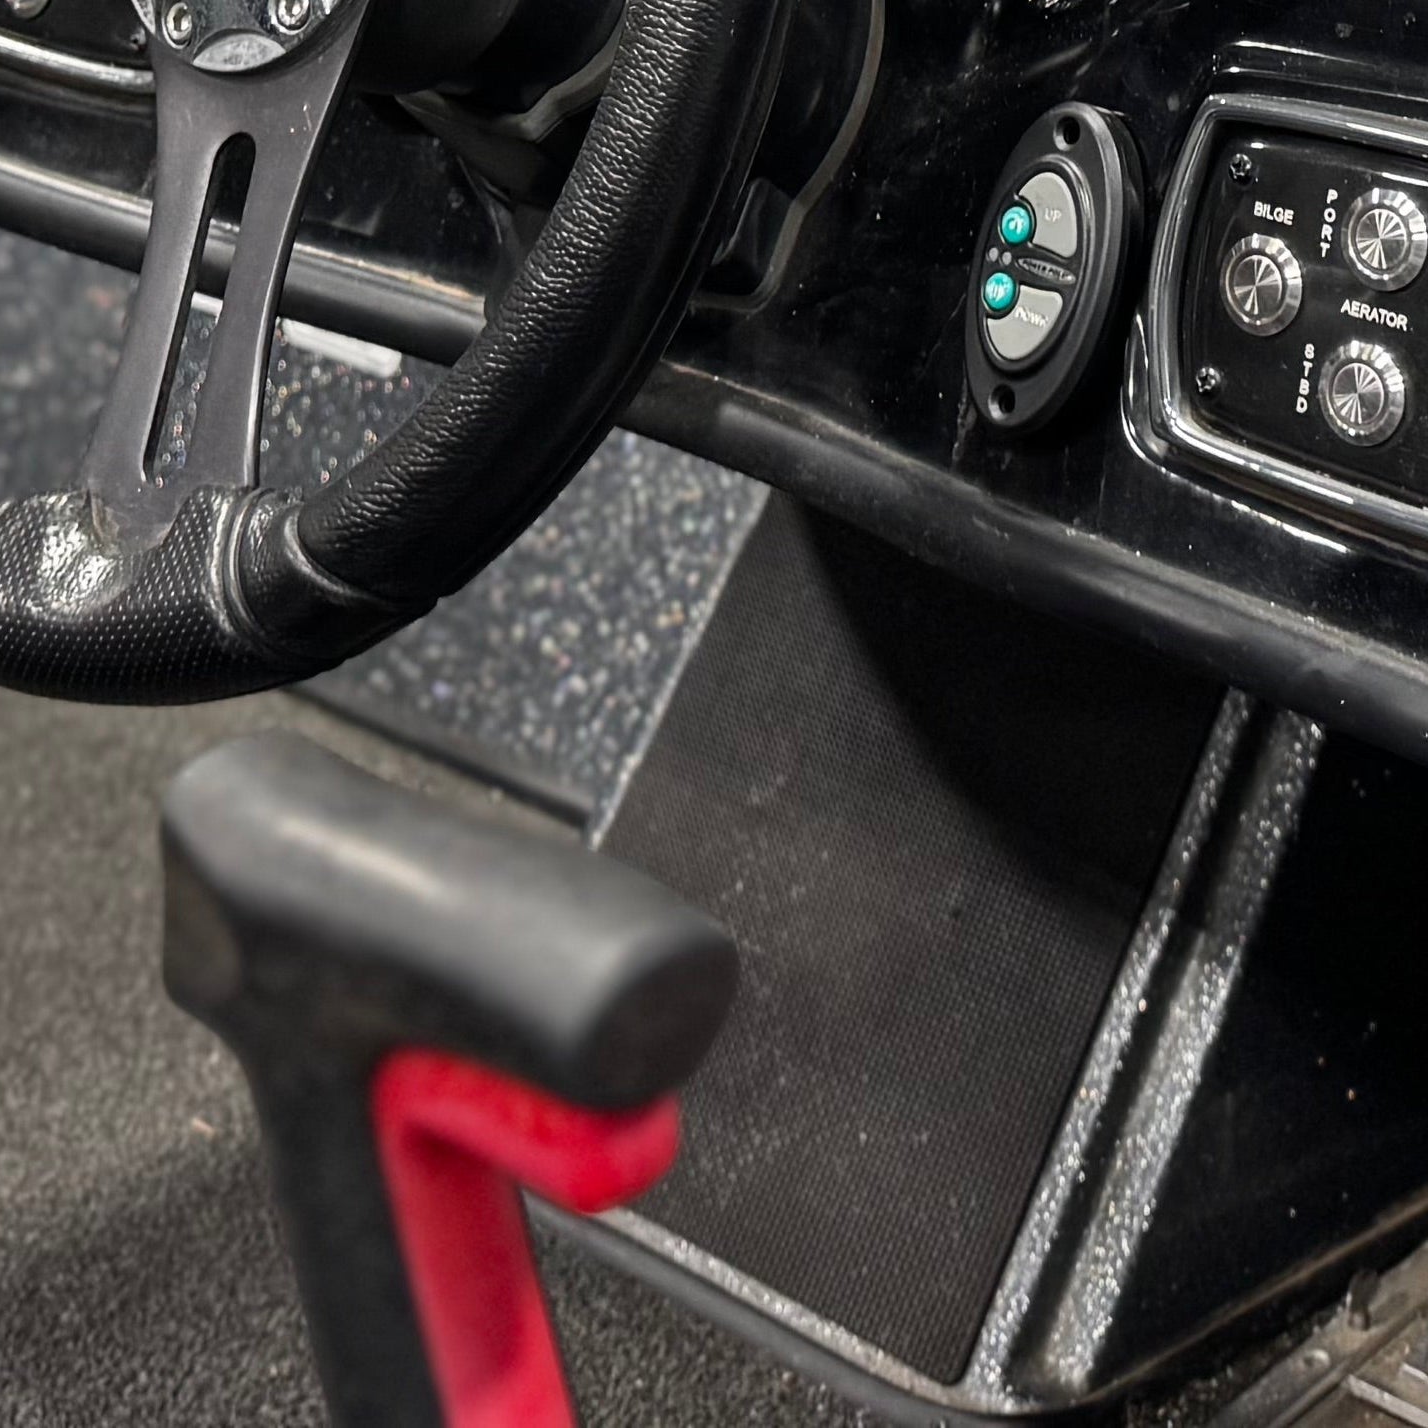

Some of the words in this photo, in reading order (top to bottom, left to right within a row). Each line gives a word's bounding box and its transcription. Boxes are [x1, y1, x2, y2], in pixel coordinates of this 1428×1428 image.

[1044, 207, 1062, 222] UP
[1253, 201, 1295, 226] BILGE
[1320, 189, 1338, 258] PORT
[1340, 299, 1408, 331] AERATOR
[1296, 343, 1315, 413] STBD
